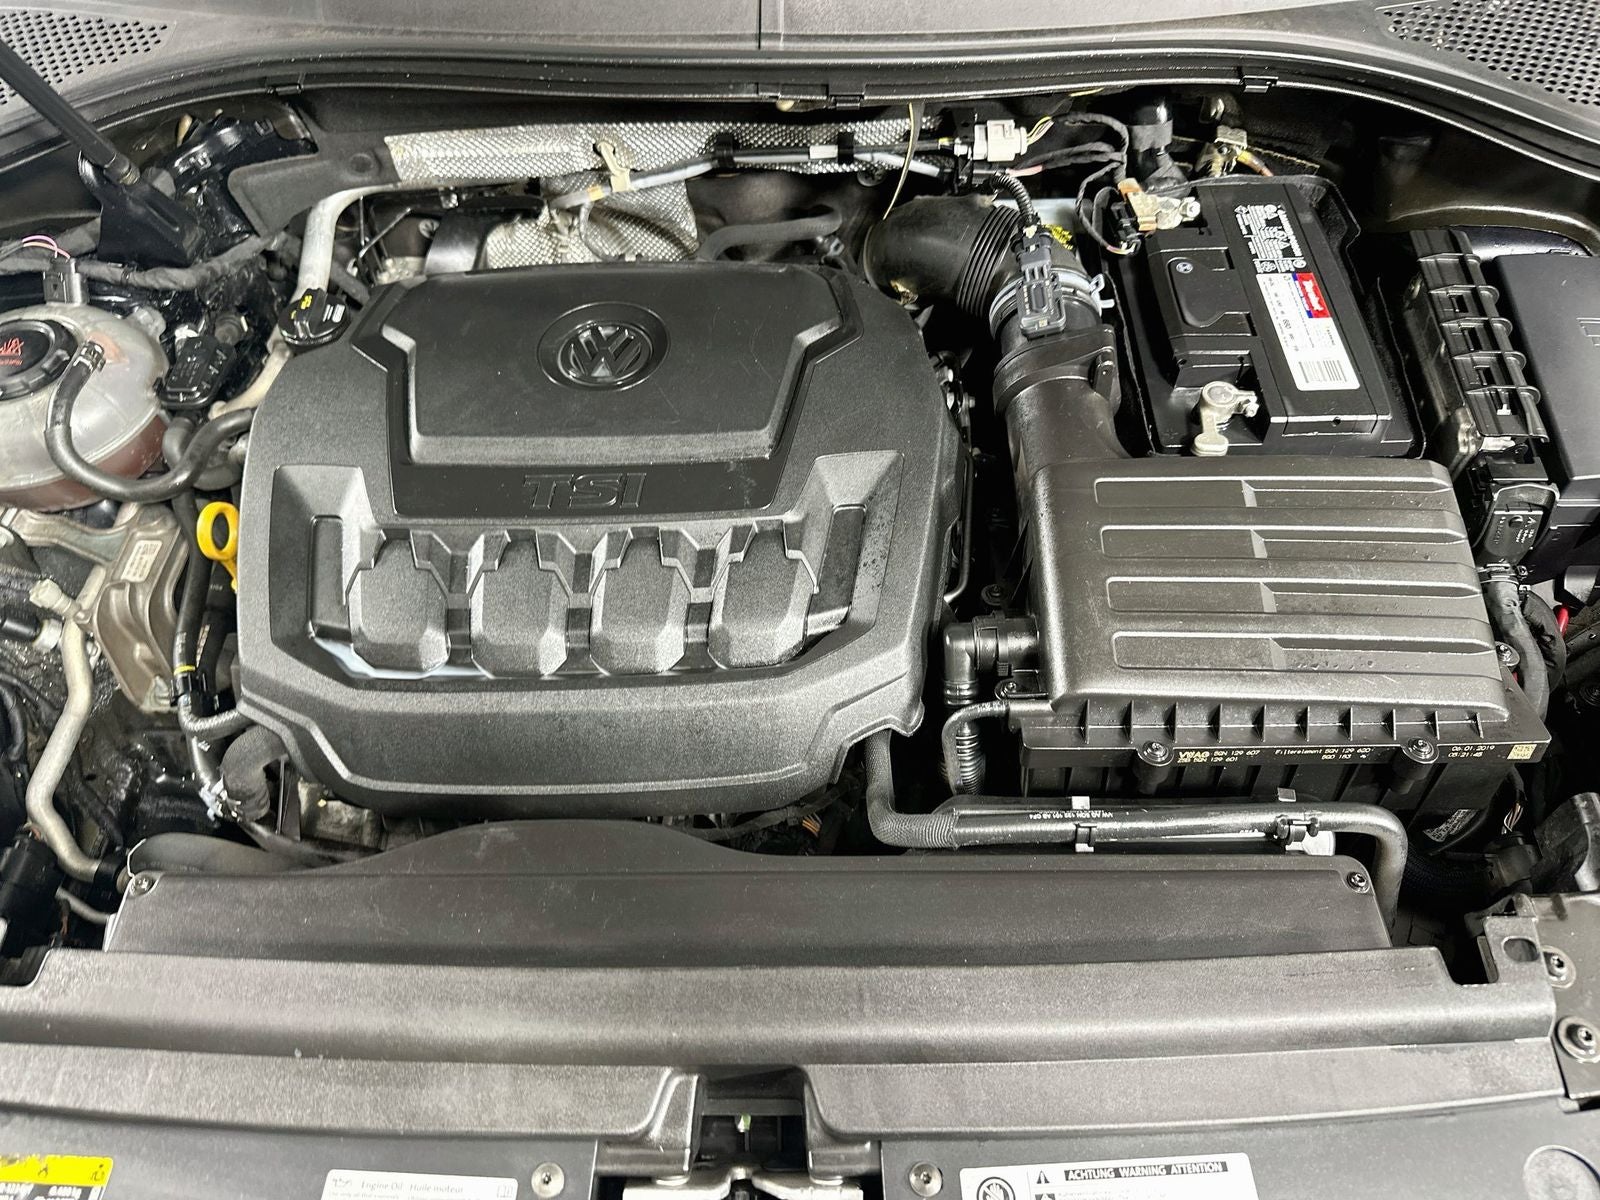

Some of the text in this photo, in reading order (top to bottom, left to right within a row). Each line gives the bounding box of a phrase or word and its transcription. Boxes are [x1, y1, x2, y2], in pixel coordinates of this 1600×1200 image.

[524, 472, 647, 509] TSI
[1068, 1161, 1223, 1181] ACHTUNG WARNING ATTENTION
[361, 1180, 389, 1192] Engine
[409, 1183, 432, 1192] Huile
[433, 1184, 463, 1194] moteur
